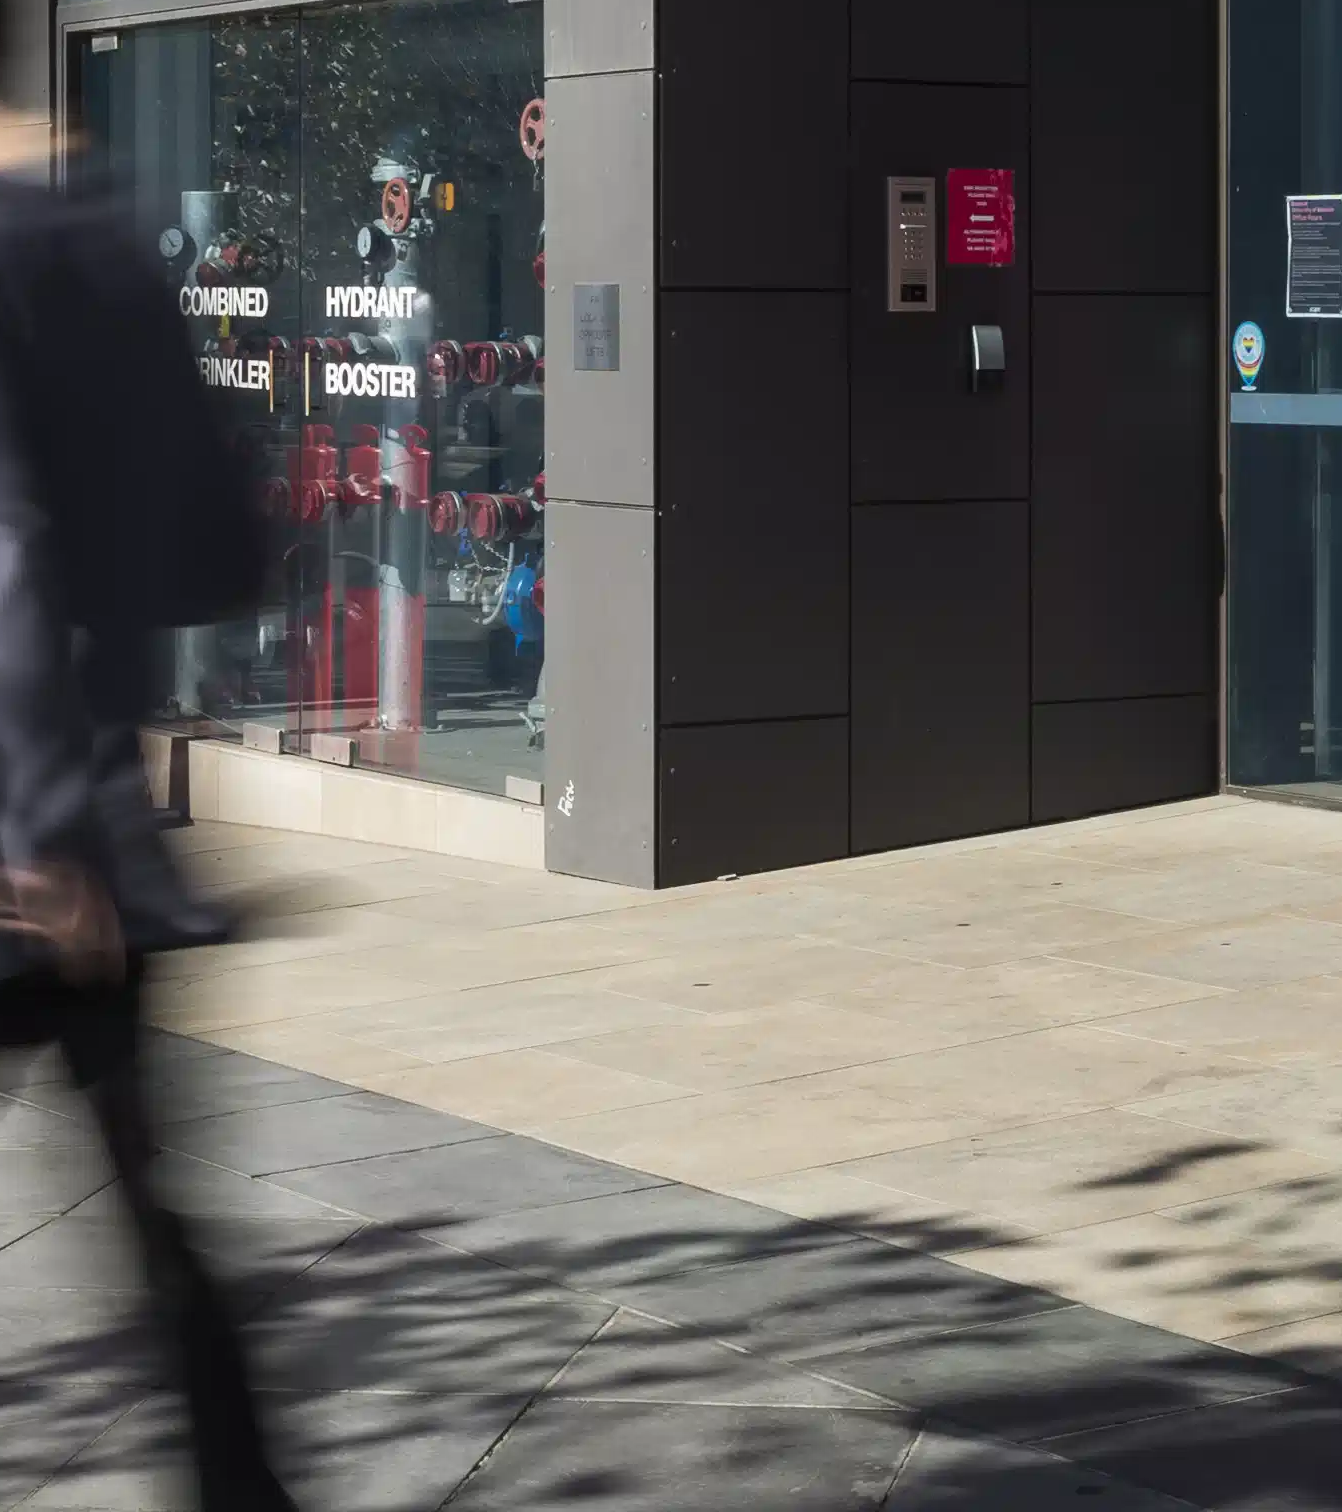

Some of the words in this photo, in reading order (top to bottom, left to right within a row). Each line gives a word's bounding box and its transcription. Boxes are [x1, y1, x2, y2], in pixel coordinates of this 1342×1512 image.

[179, 286, 269, 318] COMBINED
[325, 286, 417, 319] HYDRANT
[197, 356, 270, 391] RINKLER
[325, 362, 416, 399] BOOSTER
